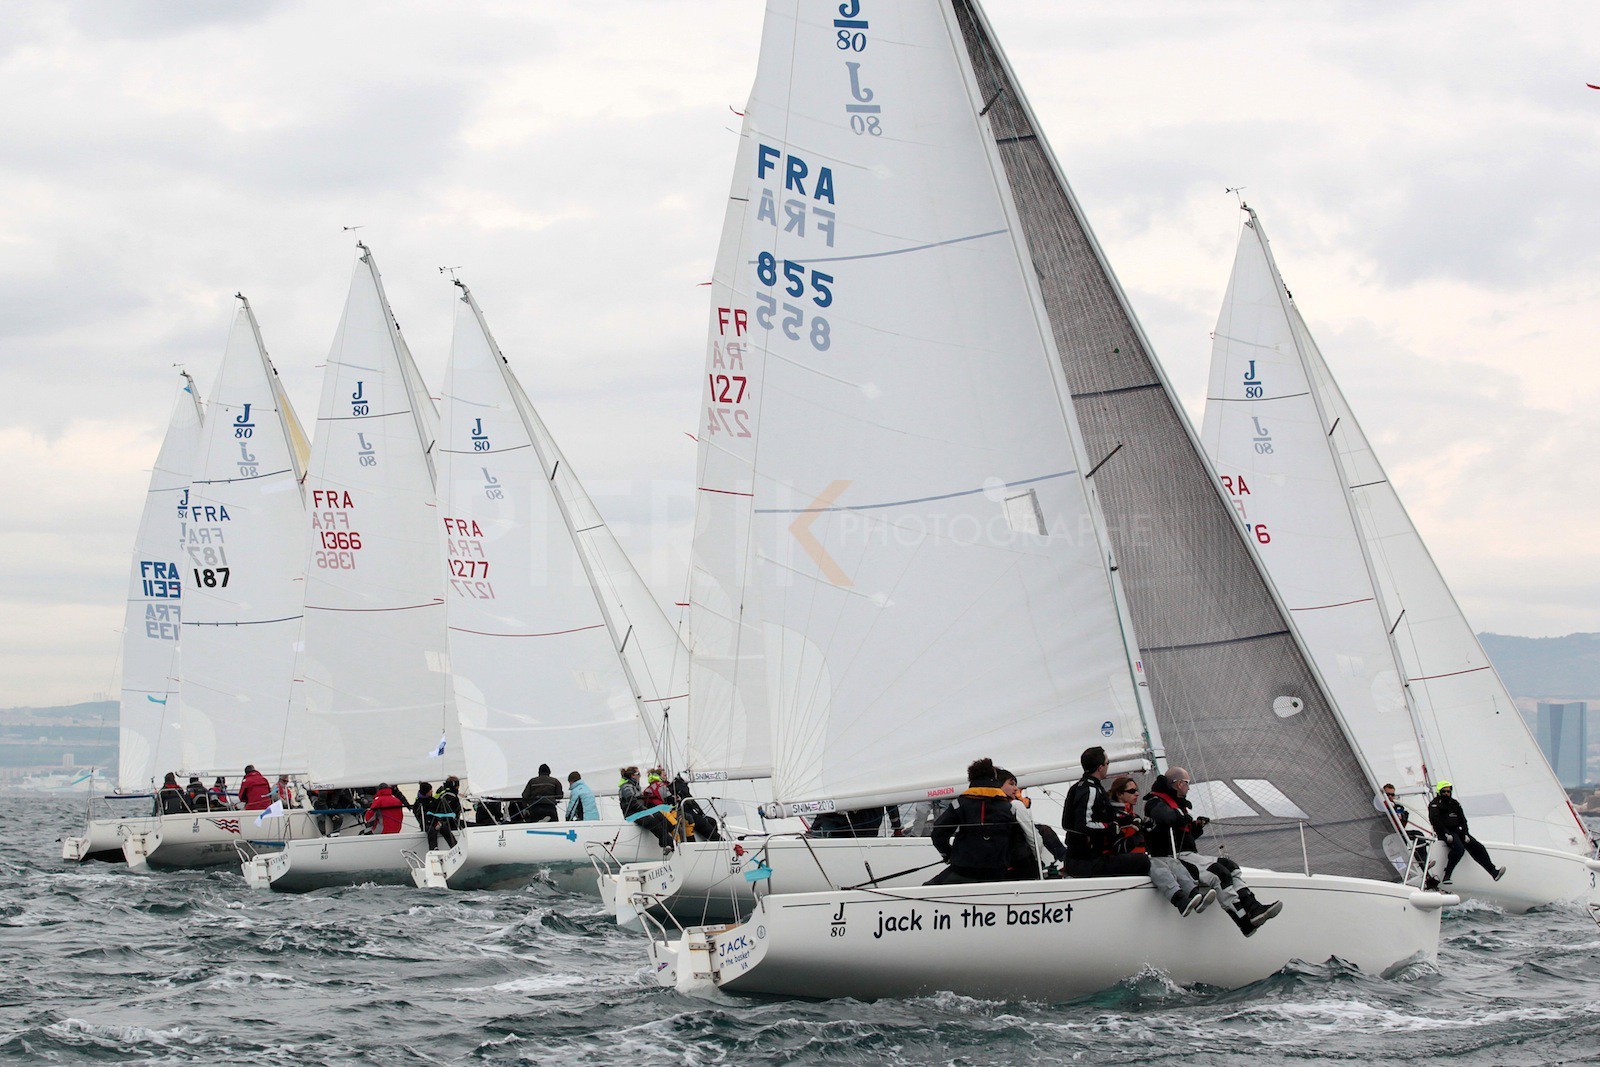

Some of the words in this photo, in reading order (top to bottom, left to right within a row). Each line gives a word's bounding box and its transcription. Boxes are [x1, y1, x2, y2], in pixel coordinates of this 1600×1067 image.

[836, 30, 866, 52] 80
[758, 143, 835, 205] FRA
[757, 251, 834, 308] 855
[718, 307, 748, 337] FR
[1244, 360, 1256, 380] J
[352, 381, 363, 400] J
[709, 374, 750, 404] 127
[1245, 386, 1264, 398] 80
[236, 404, 252, 424] J
[352, 404, 369, 416] 80
[234, 428, 252, 439] 80
[472, 418, 482, 436] J
[474, 440, 490, 451] 80
[1220, 475, 1250, 496] RA
[180, 489, 190, 506] J
[313, 490, 354, 508] FRA
[192, 505, 231, 522] FRA
[444, 518, 484, 537] FRA
[320, 531, 362, 550] 1366
[140, 561, 180, 580] FRA
[194, 568, 230, 588] 187
[448, 559, 489, 579] 1277
[142, 580, 181, 598] 1139
[928, 787, 954, 797] HARKEN
[818, 800, 835, 811] 2013
[648, 865, 673, 881] ALHENA
[833, 902, 845, 921] J
[873, 908, 922, 939] jack
[933, 909, 950, 930] in
[960, 906, 996, 928] the
[1006, 904, 1074, 926] basket
[830, 926, 846, 937] 80
[720, 935, 747, 956] JACK
